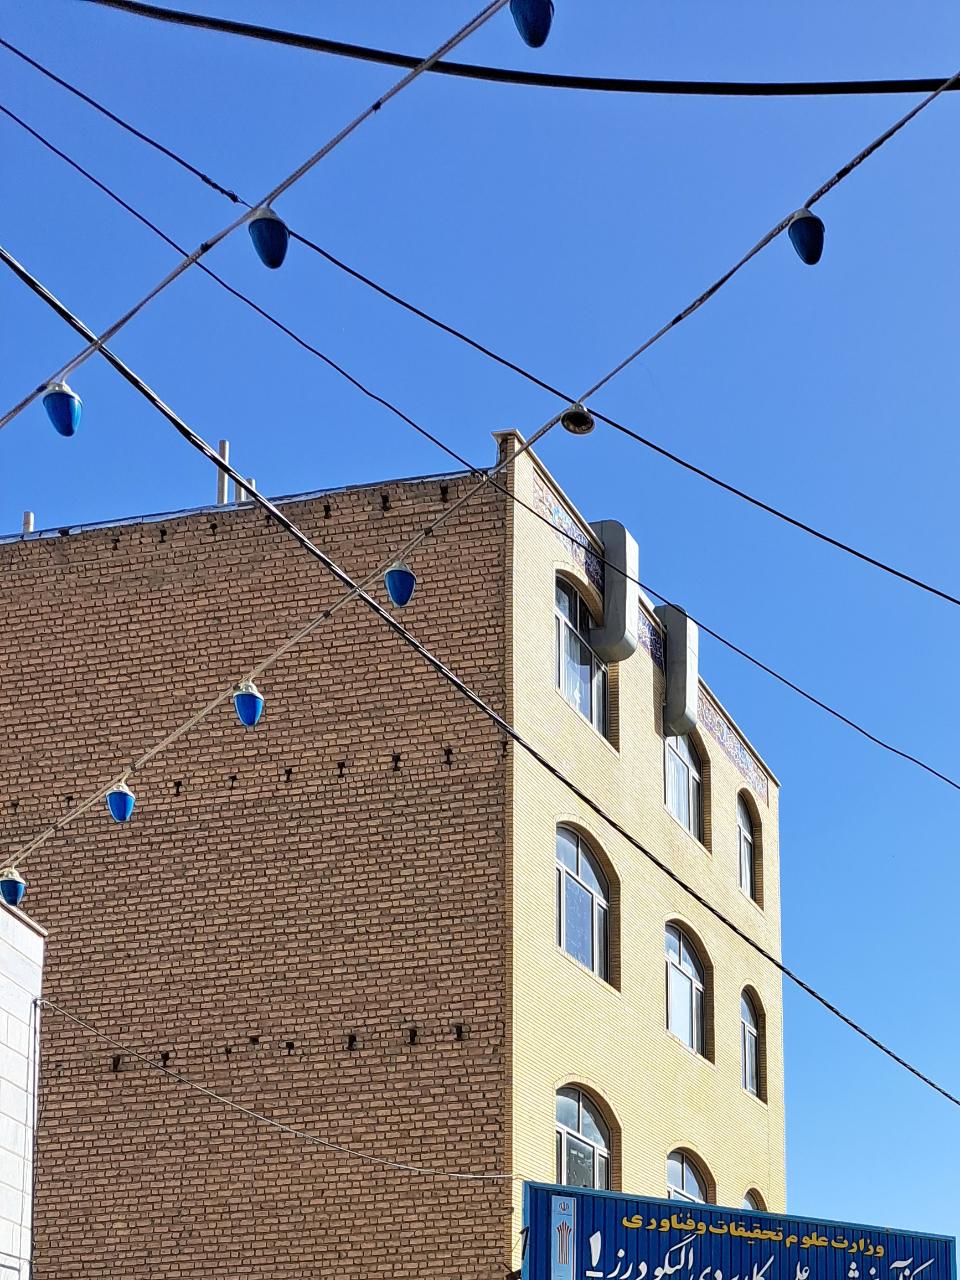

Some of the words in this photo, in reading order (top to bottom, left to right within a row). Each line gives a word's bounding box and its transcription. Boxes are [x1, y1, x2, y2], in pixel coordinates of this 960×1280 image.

[708, 1220, 783, 1244] تحقیقات
[785, 1231, 829, 1249] علوم
[831, 1235, 885, 1257] وزارت
